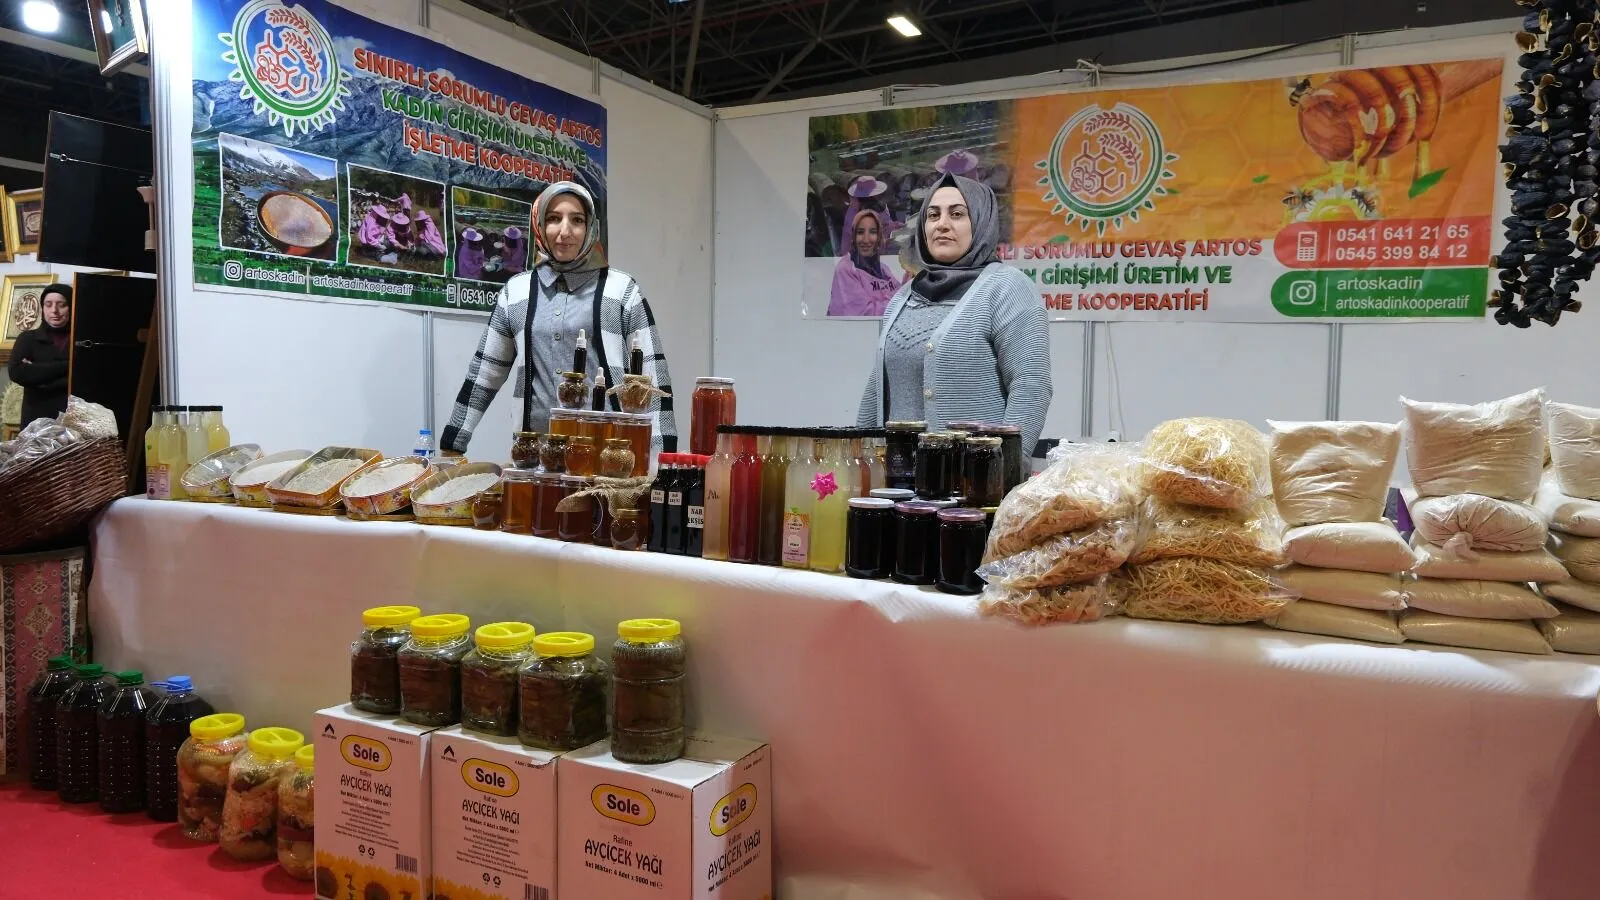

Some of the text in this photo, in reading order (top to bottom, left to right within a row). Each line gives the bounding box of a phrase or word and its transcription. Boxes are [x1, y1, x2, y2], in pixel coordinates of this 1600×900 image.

[428, 72, 507, 116] SORUMLU
[509, 102, 558, 135] GEVAŞ
[560, 117, 602, 147] ARTOS
[382, 88, 587, 167] KADIN GİRİŞİMİ ÜRETİM VE
[403, 119, 476, 164] İŞLETME
[1336, 224, 1469, 242] 0541 641 21 65
[1023, 240, 1116, 259] SORUMLU
[1120, 239, 1187, 260] GEVAŞ
[1191, 238, 1263, 257] ARTOS
[1335, 243, 1468, 261] 0545 399 84 12
[244, 267, 413, 297] artoskadin artoskadinkooperatif
[1041, 262, 1118, 289] GİRİŞİMİ
[1123, 260, 1199, 284] ÜRETİM
[1204, 265, 1232, 284] VE
[1336, 276, 1423, 290] artoskadin
[461, 288, 499, 305] 0541 64
[1077, 287, 1209, 310] KOOPERATİFİ
[1335, 294, 1470, 312] artoskadinkooperatif
[353, 743, 380, 763] Sole
[475, 767, 506, 788] Sole
[607, 793, 641, 816] Sole
[721, 798, 747, 823] Sole
[584, 838, 662, 876] AYÇİÇEK YAĞI
